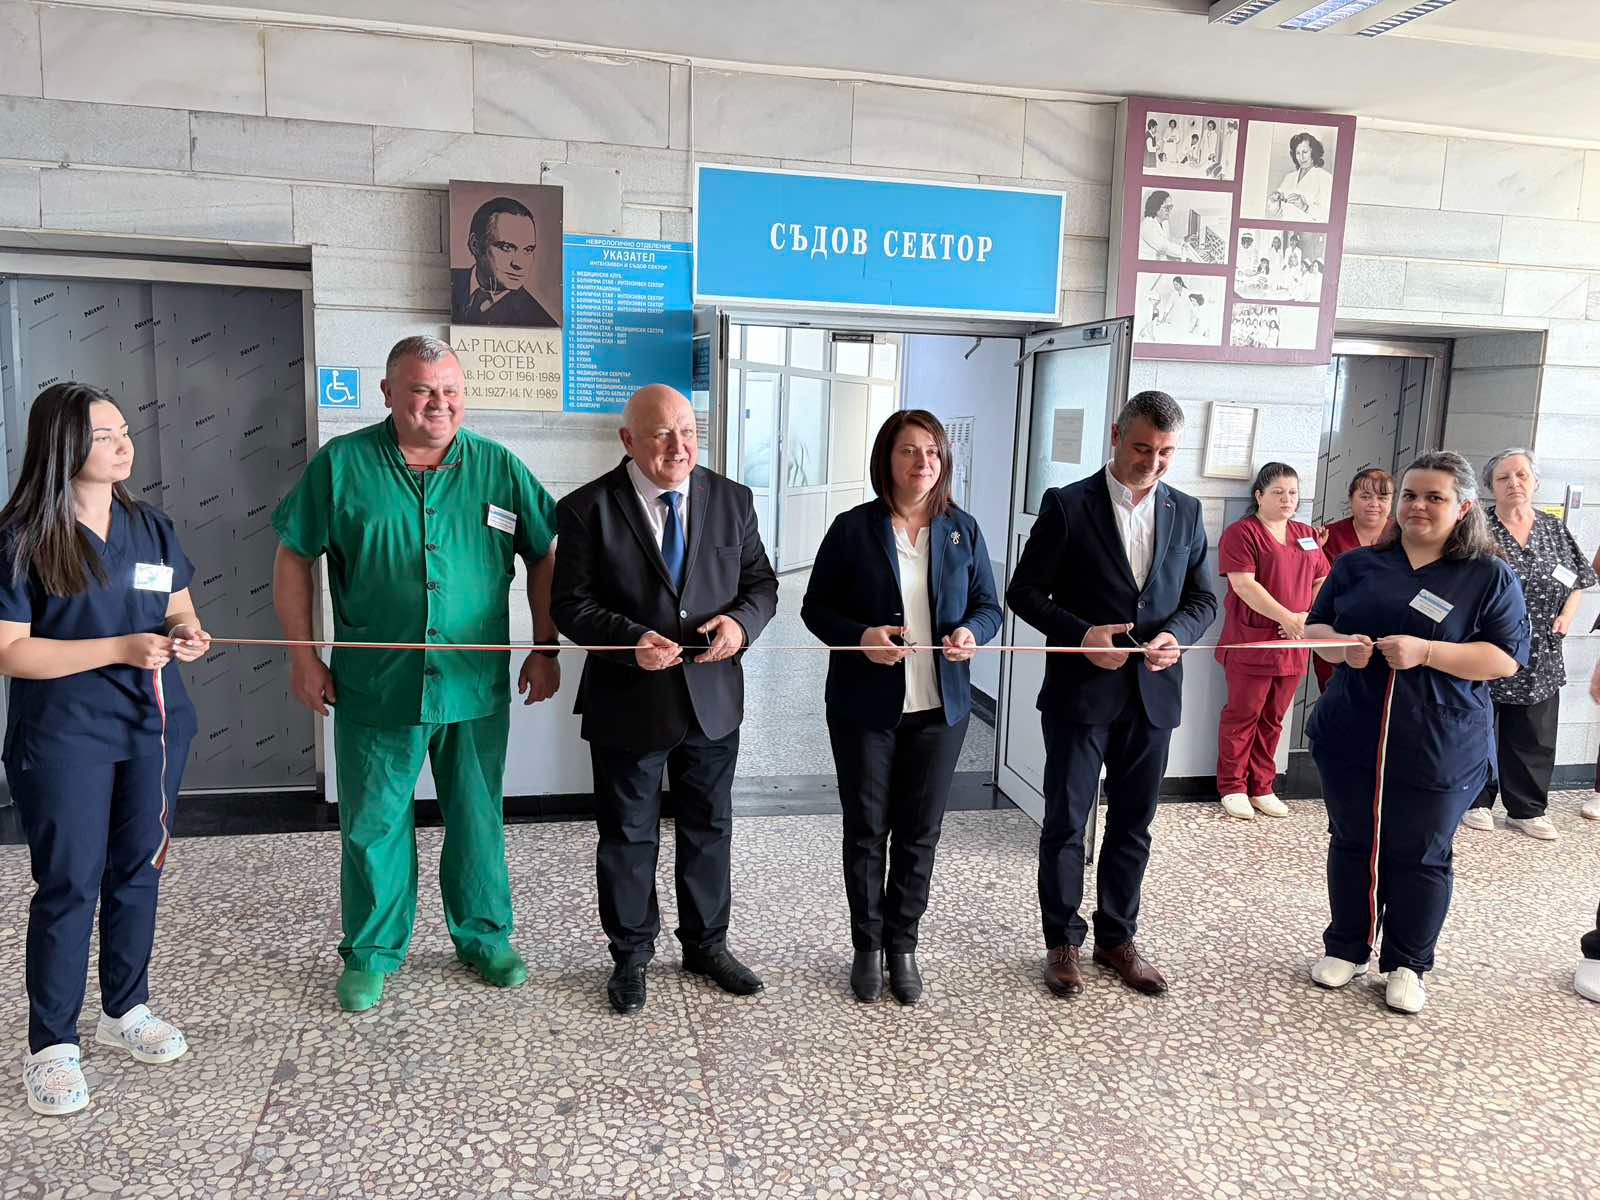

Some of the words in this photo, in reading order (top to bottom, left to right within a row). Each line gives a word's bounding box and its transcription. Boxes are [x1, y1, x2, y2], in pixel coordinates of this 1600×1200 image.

[585, 239, 634, 248] НЕВРОЛОГИЧНО
[636, 241, 672, 250] ОТДЕЛЕНИЕ
[769, 221, 868, 261] СЪДОВ
[883, 229, 993, 262] СЕКТОР
[603, 249, 656, 263] УКАЗАТЕЛ
[484, 338, 543, 354] ПАСКАЛ
[479, 354, 536, 369] ФОТЕВ
[477, 370, 496, 380] НО
[499, 370, 514, 381] ОТ
[536, 388, 558, 399] 1989
